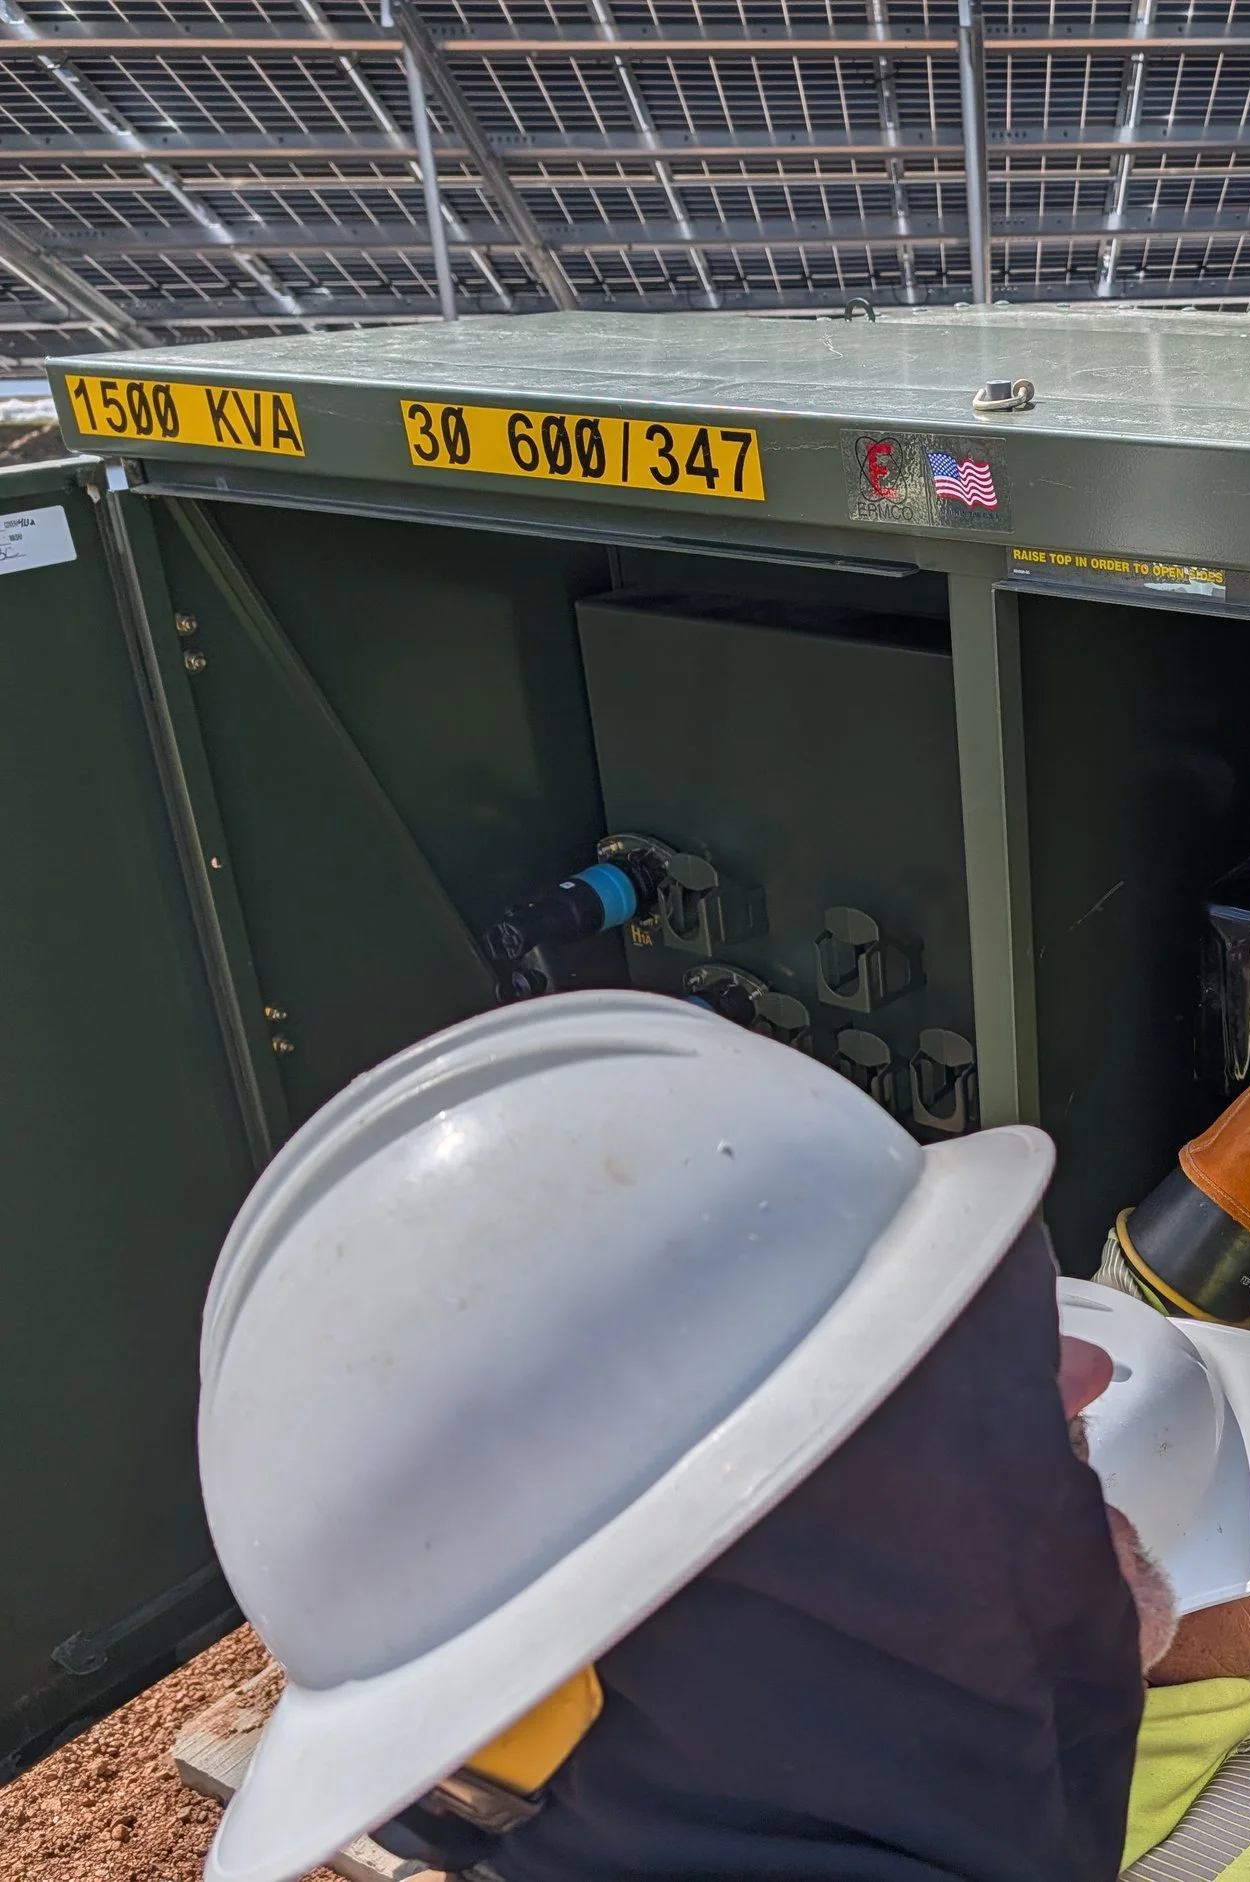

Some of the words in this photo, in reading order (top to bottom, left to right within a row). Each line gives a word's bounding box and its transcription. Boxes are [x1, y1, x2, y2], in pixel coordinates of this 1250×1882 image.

[205, 388, 303, 452] KVA
[857, 502, 914, 521] ERMCO
[1013, 549, 1046, 563] RAISE
[1049, 553, 1072, 566] TOP
[1075, 556, 1087, 568] IN
[1090, 558, 1130, 573] ORDER
[1133, 563, 1149, 575] TO
[1152, 564, 1184, 579] OPEN
